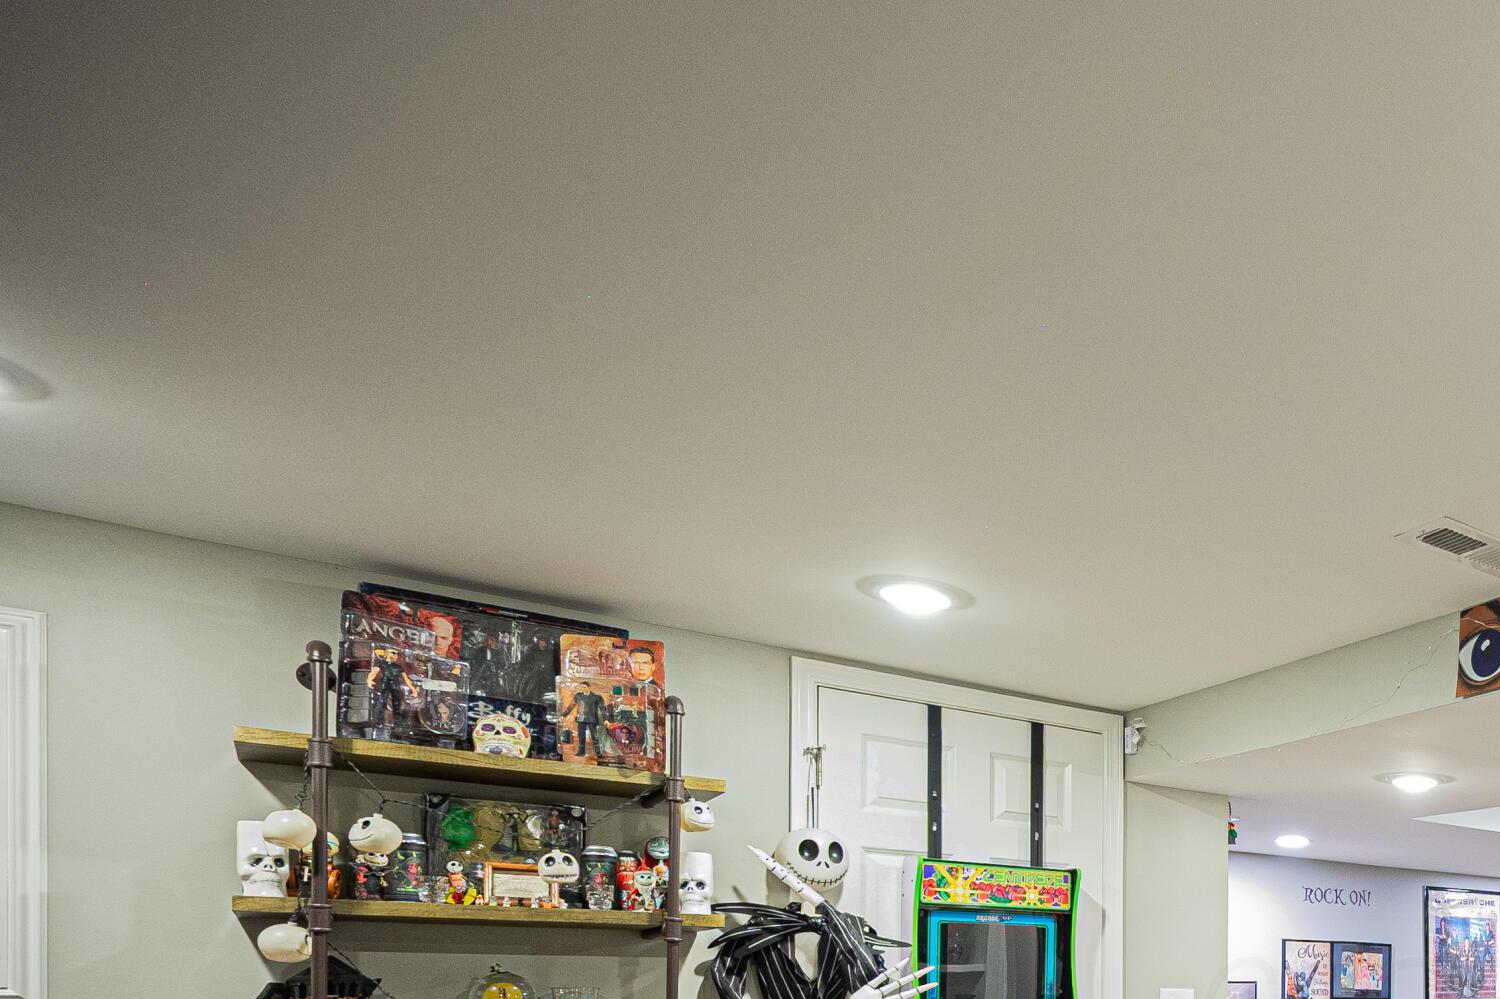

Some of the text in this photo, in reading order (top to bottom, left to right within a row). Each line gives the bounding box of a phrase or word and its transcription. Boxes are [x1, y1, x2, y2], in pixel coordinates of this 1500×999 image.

[467, 700, 531, 726] Bffy
[1302, 885, 1371, 907] ROCK ON!
[1298, 944, 1328, 960] Music
